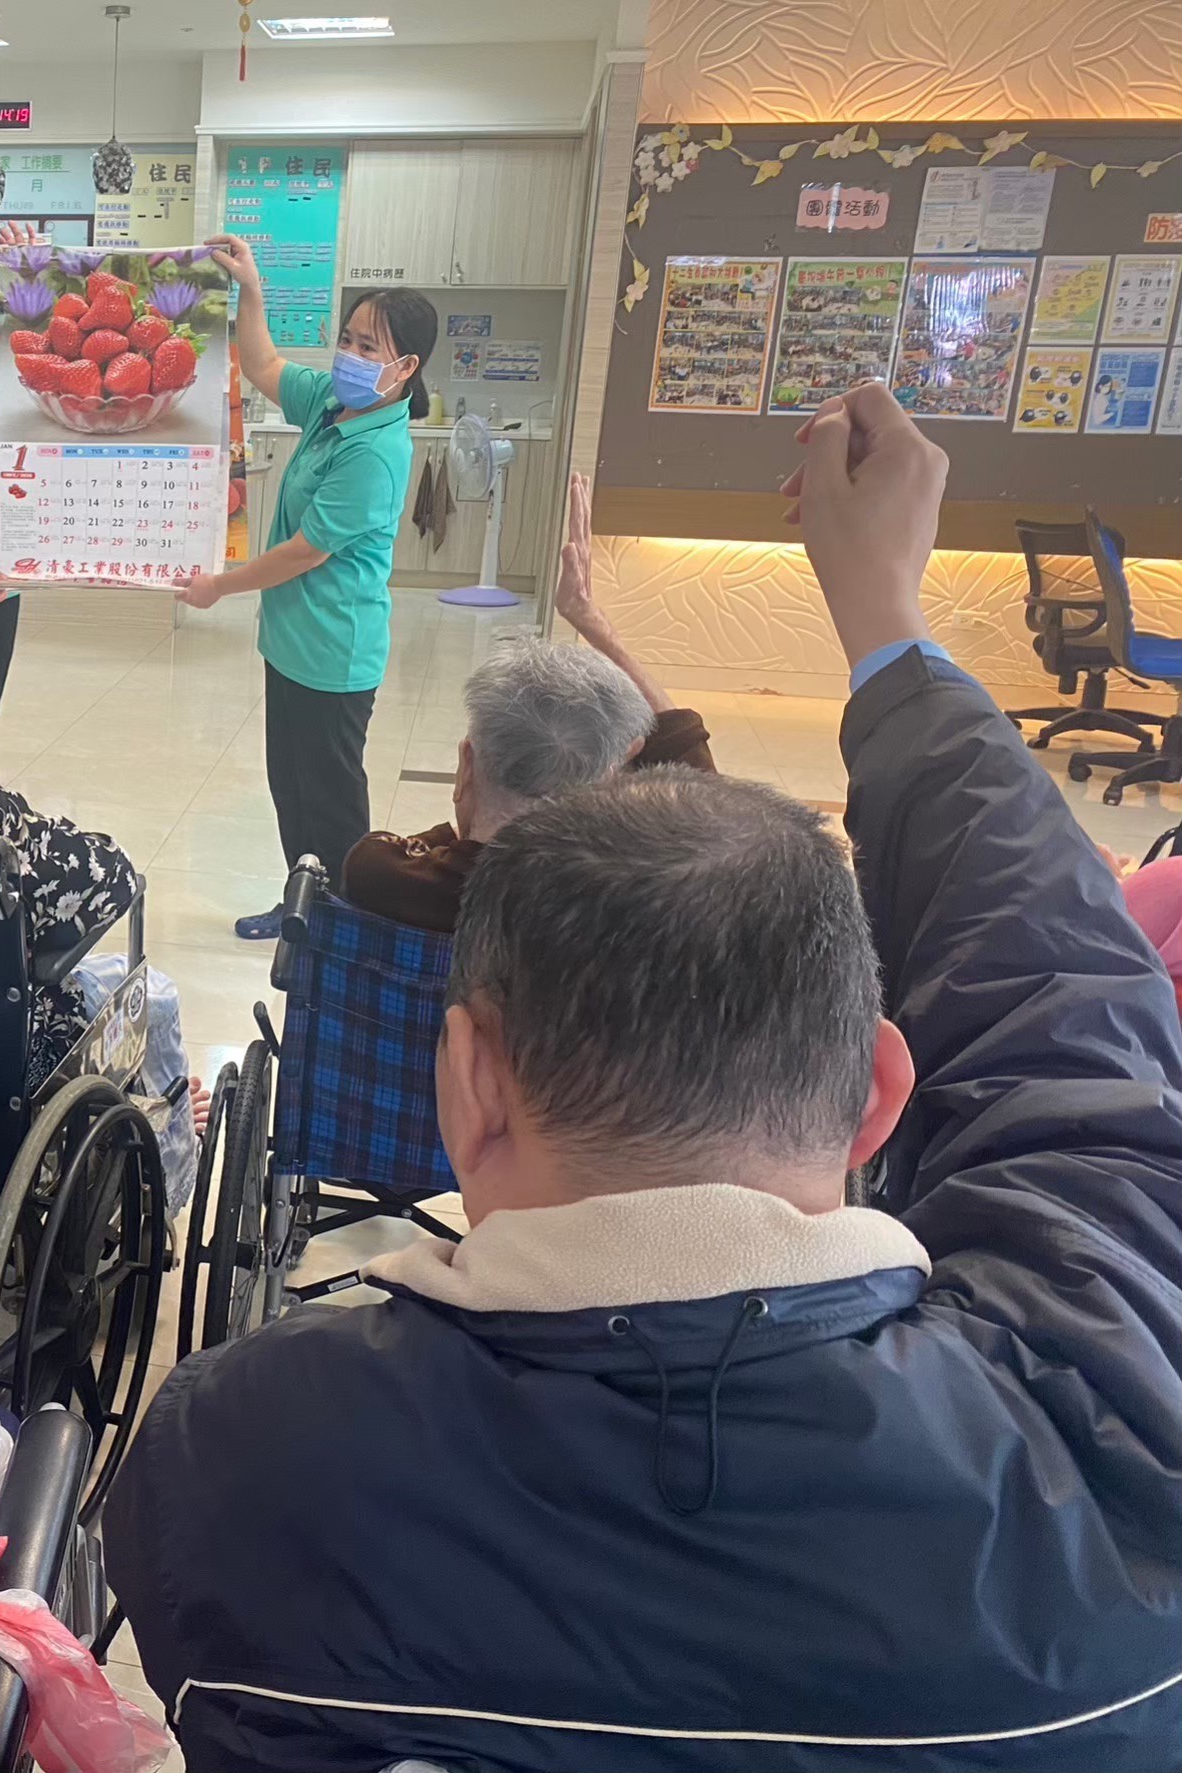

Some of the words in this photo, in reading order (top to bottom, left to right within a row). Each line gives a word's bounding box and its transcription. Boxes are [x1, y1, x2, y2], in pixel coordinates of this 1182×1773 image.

[149, 163, 191, 183] 住民
[286, 156, 331, 178] 住民
[31, 179, 43, 192] 月
[350, 268, 404, 279] 住院中病歷
[163, 481, 175, 490] 10
[189, 482, 199, 490] 11
[38, 498, 49, 506] 12
[63, 498, 74, 506] 13
[88, 499, 99, 507] 14
[113, 499, 124, 507] 15
[138, 500, 149, 508] 16
[163, 500, 174, 509] 17
[188, 502, 199, 510] 18
[38, 517, 49, 525] 19
[63, 517, 74, 525] 20
[88, 518, 98, 526] 21
[112, 519, 124, 527] 22
[137, 519, 148, 527] 23
[162, 520, 173, 528] 24
[187, 521, 198, 529] 25
[38, 535, 50, 543] 26
[63, 536, 74, 544] 27
[87, 536, 98, 545] 28
[112, 538, 123, 546] 29
[135, 539, 147, 547] 30
[161, 540, 171, 548] 31
